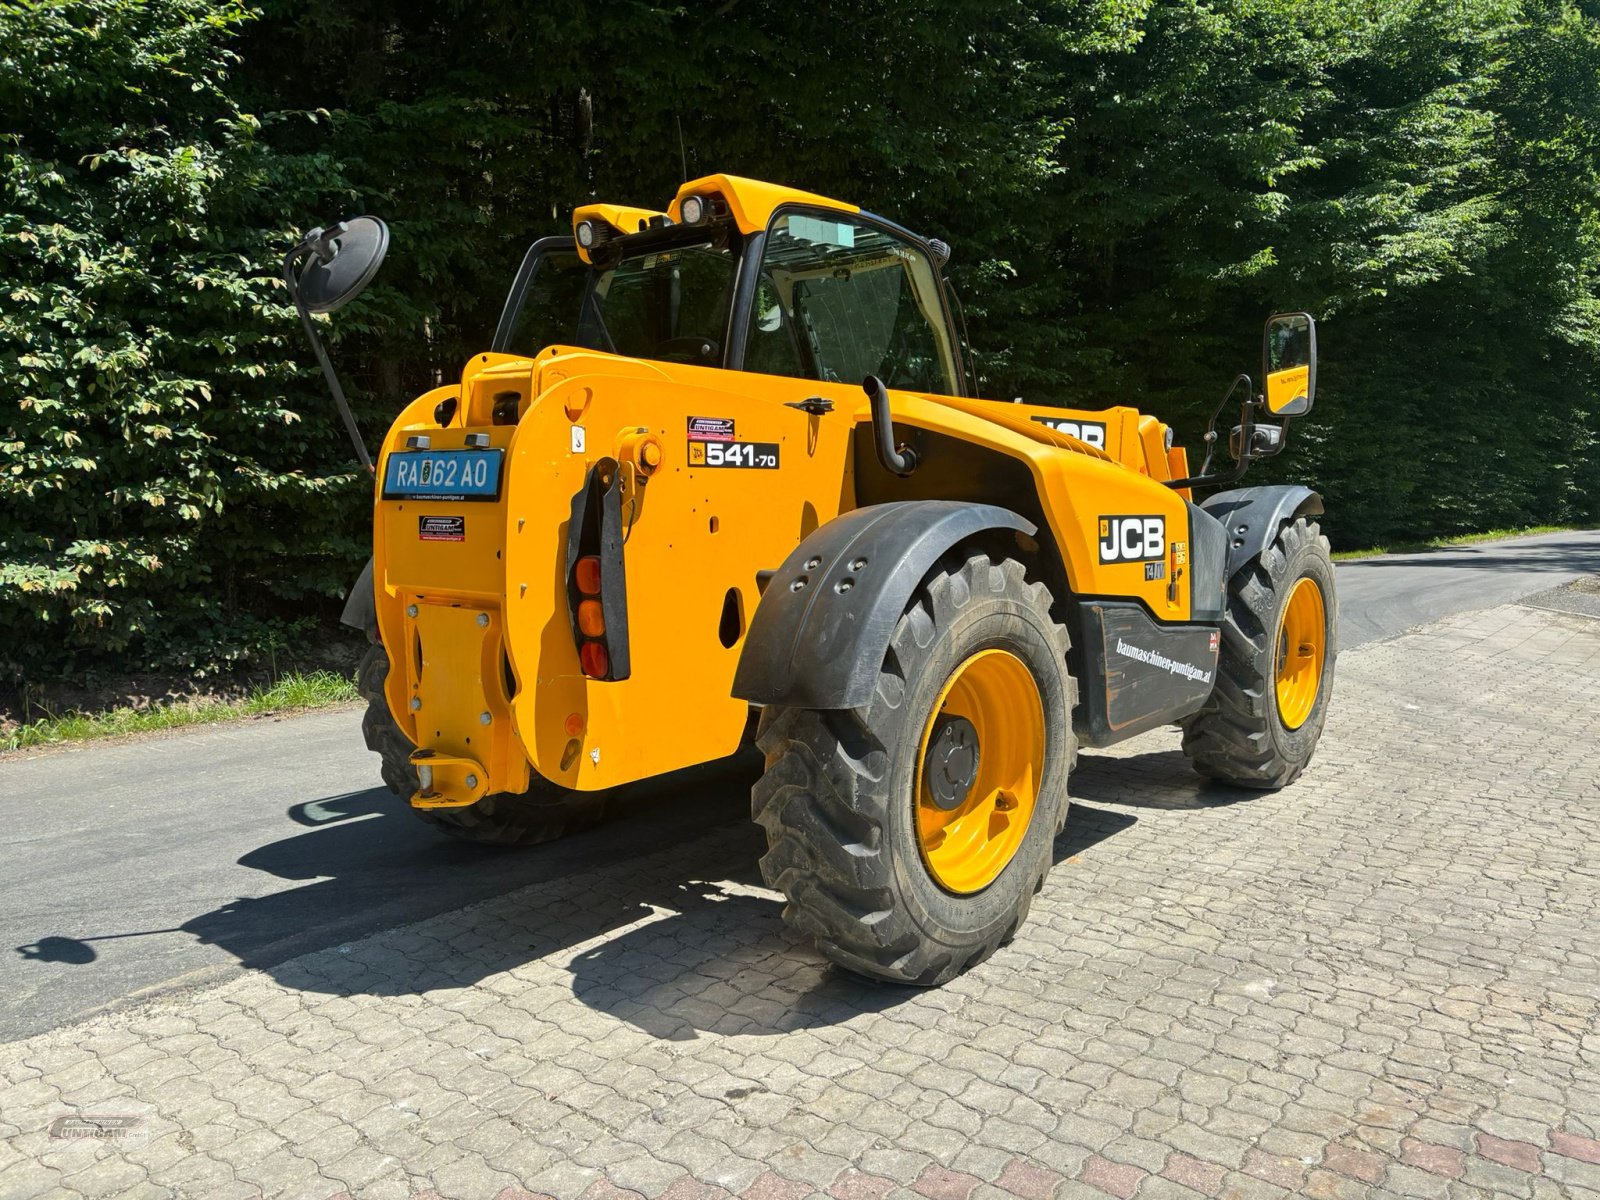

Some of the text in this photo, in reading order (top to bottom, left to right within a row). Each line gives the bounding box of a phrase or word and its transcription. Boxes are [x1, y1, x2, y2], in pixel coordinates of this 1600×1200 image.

[397, 460, 418, 487] RA
[432, 459, 458, 487] 62
[1100, 518, 1164, 560] JCB
[1116, 637, 1212, 684] baumaschinen-puntigam.at
